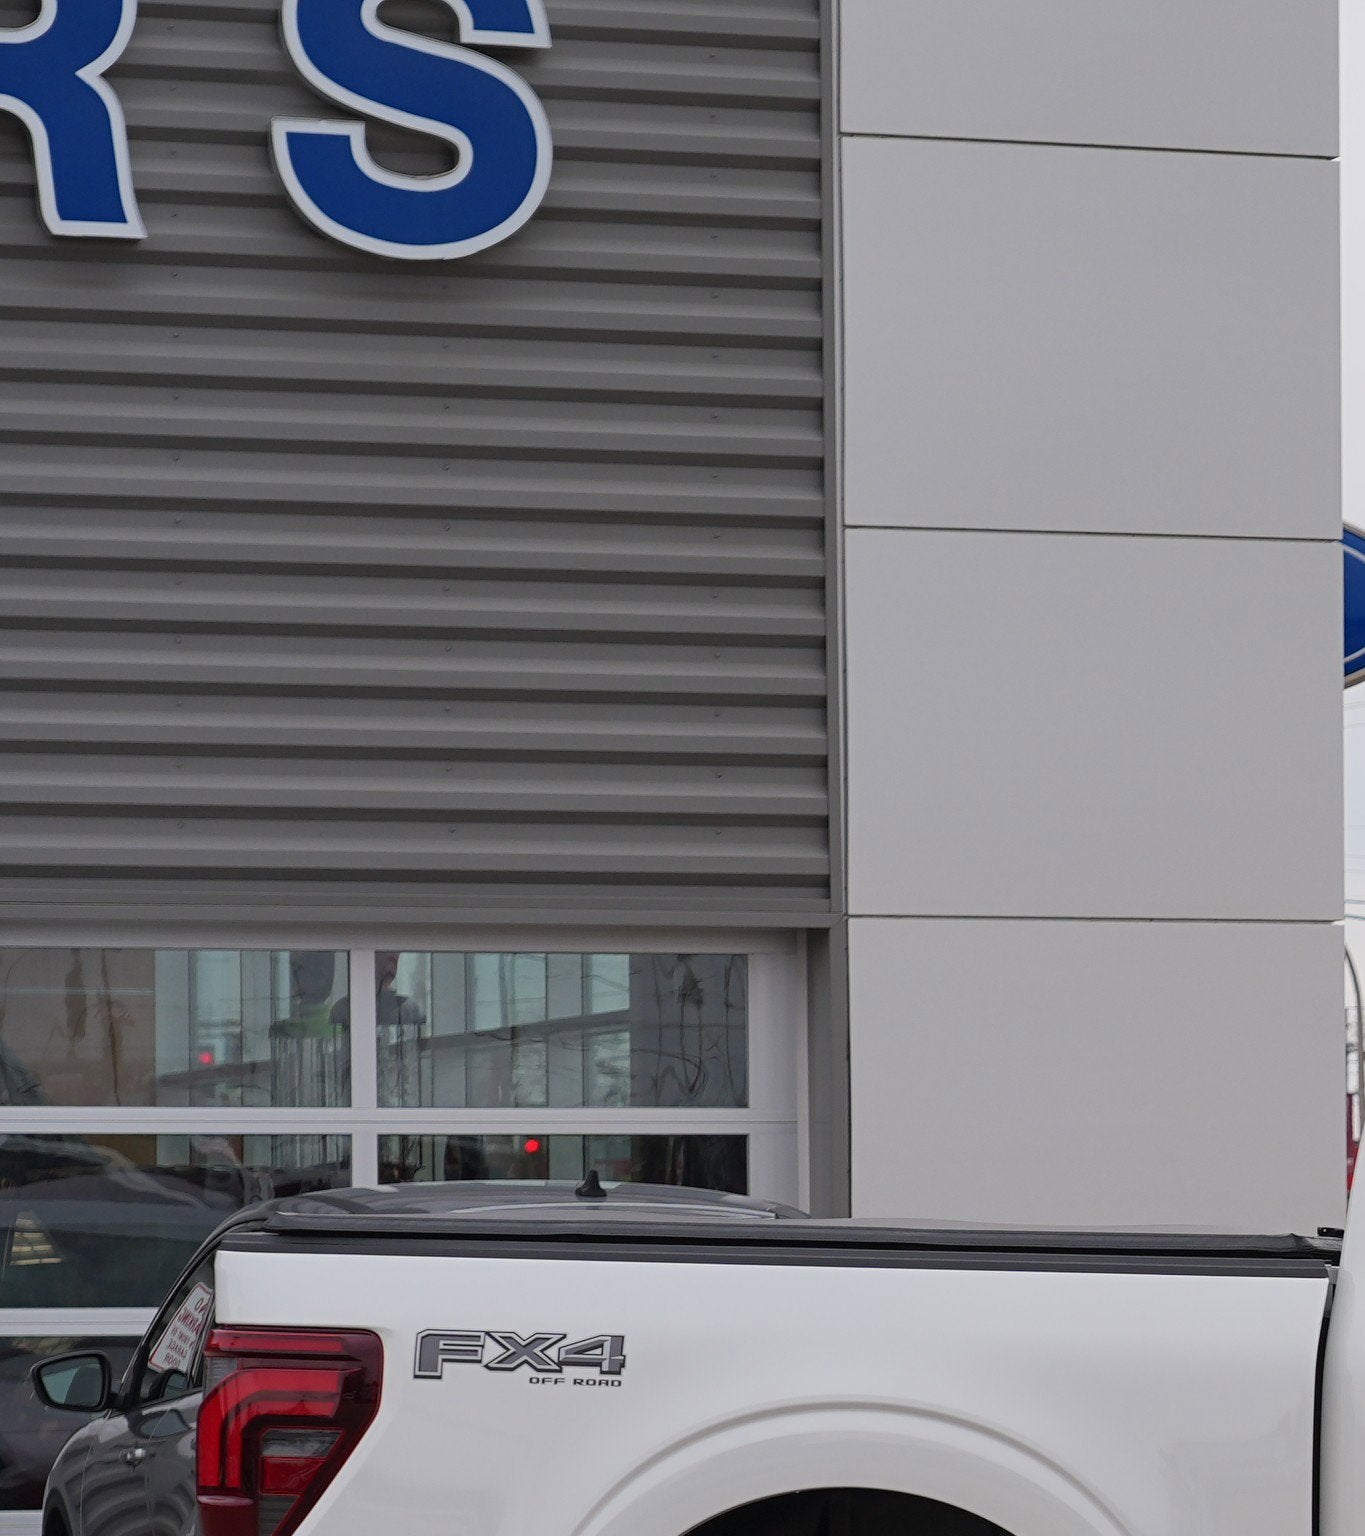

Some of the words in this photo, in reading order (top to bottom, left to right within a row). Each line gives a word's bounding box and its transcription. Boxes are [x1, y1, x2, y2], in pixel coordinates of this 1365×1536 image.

[413, 1328, 626, 1380] FX4
[529, 1376, 565, 1386] OFF
[573, 1378, 622, 1388] ROAD
